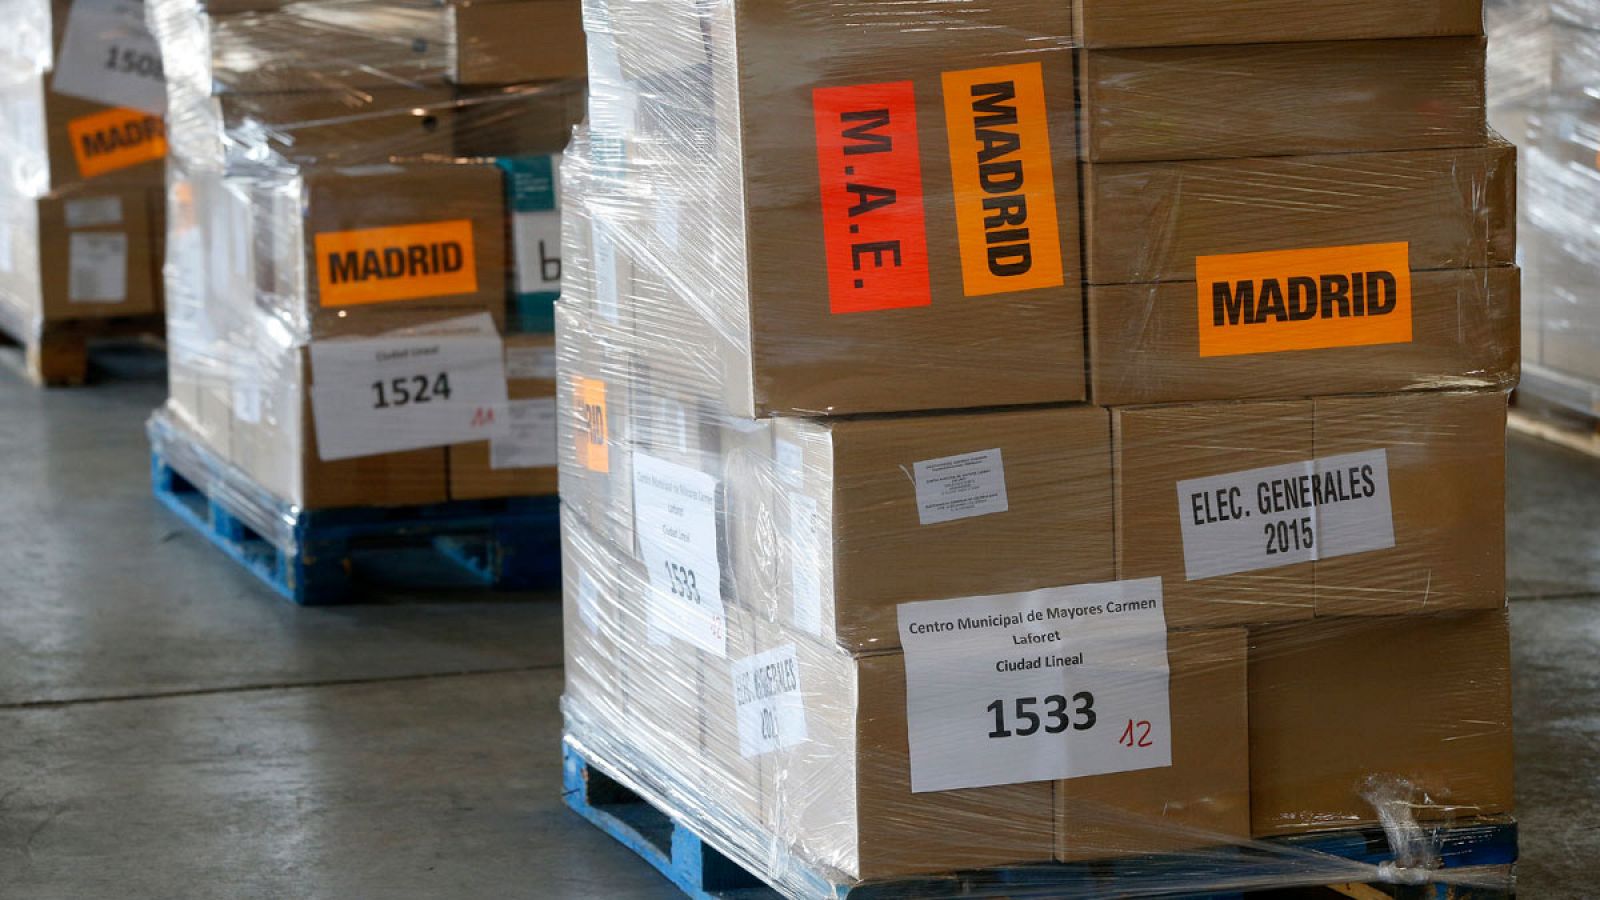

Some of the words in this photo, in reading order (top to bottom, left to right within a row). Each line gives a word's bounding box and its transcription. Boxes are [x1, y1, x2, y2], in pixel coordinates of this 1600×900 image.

[839, 107, 903, 290] M.A.E.
[970, 79, 1033, 278] MADRID
[328, 241, 464, 284] MADRID
[1211, 269, 1398, 327] MADRID
[372, 372, 452, 409] 1524
[1191, 485, 1250, 526] ELEC.
[1256, 464, 1376, 515] GENERALES
[1264, 516, 1314, 555] 2015
[665, 560, 701, 604] 1533
[909, 619, 955, 635] Centro
[957, 612, 1023, 631] Municipal
[1027, 609, 1044, 623] de
[1046, 603, 1104, 621] Mayores
[1106, 598, 1157, 614] Carmen
[1012, 630, 1061, 646] Laforet
[995, 656, 1041, 673] Ciudad
[1045, 652, 1084, 668] Lineal
[986, 690, 1097, 739] 1533
[1119, 719, 1153, 747] 12
